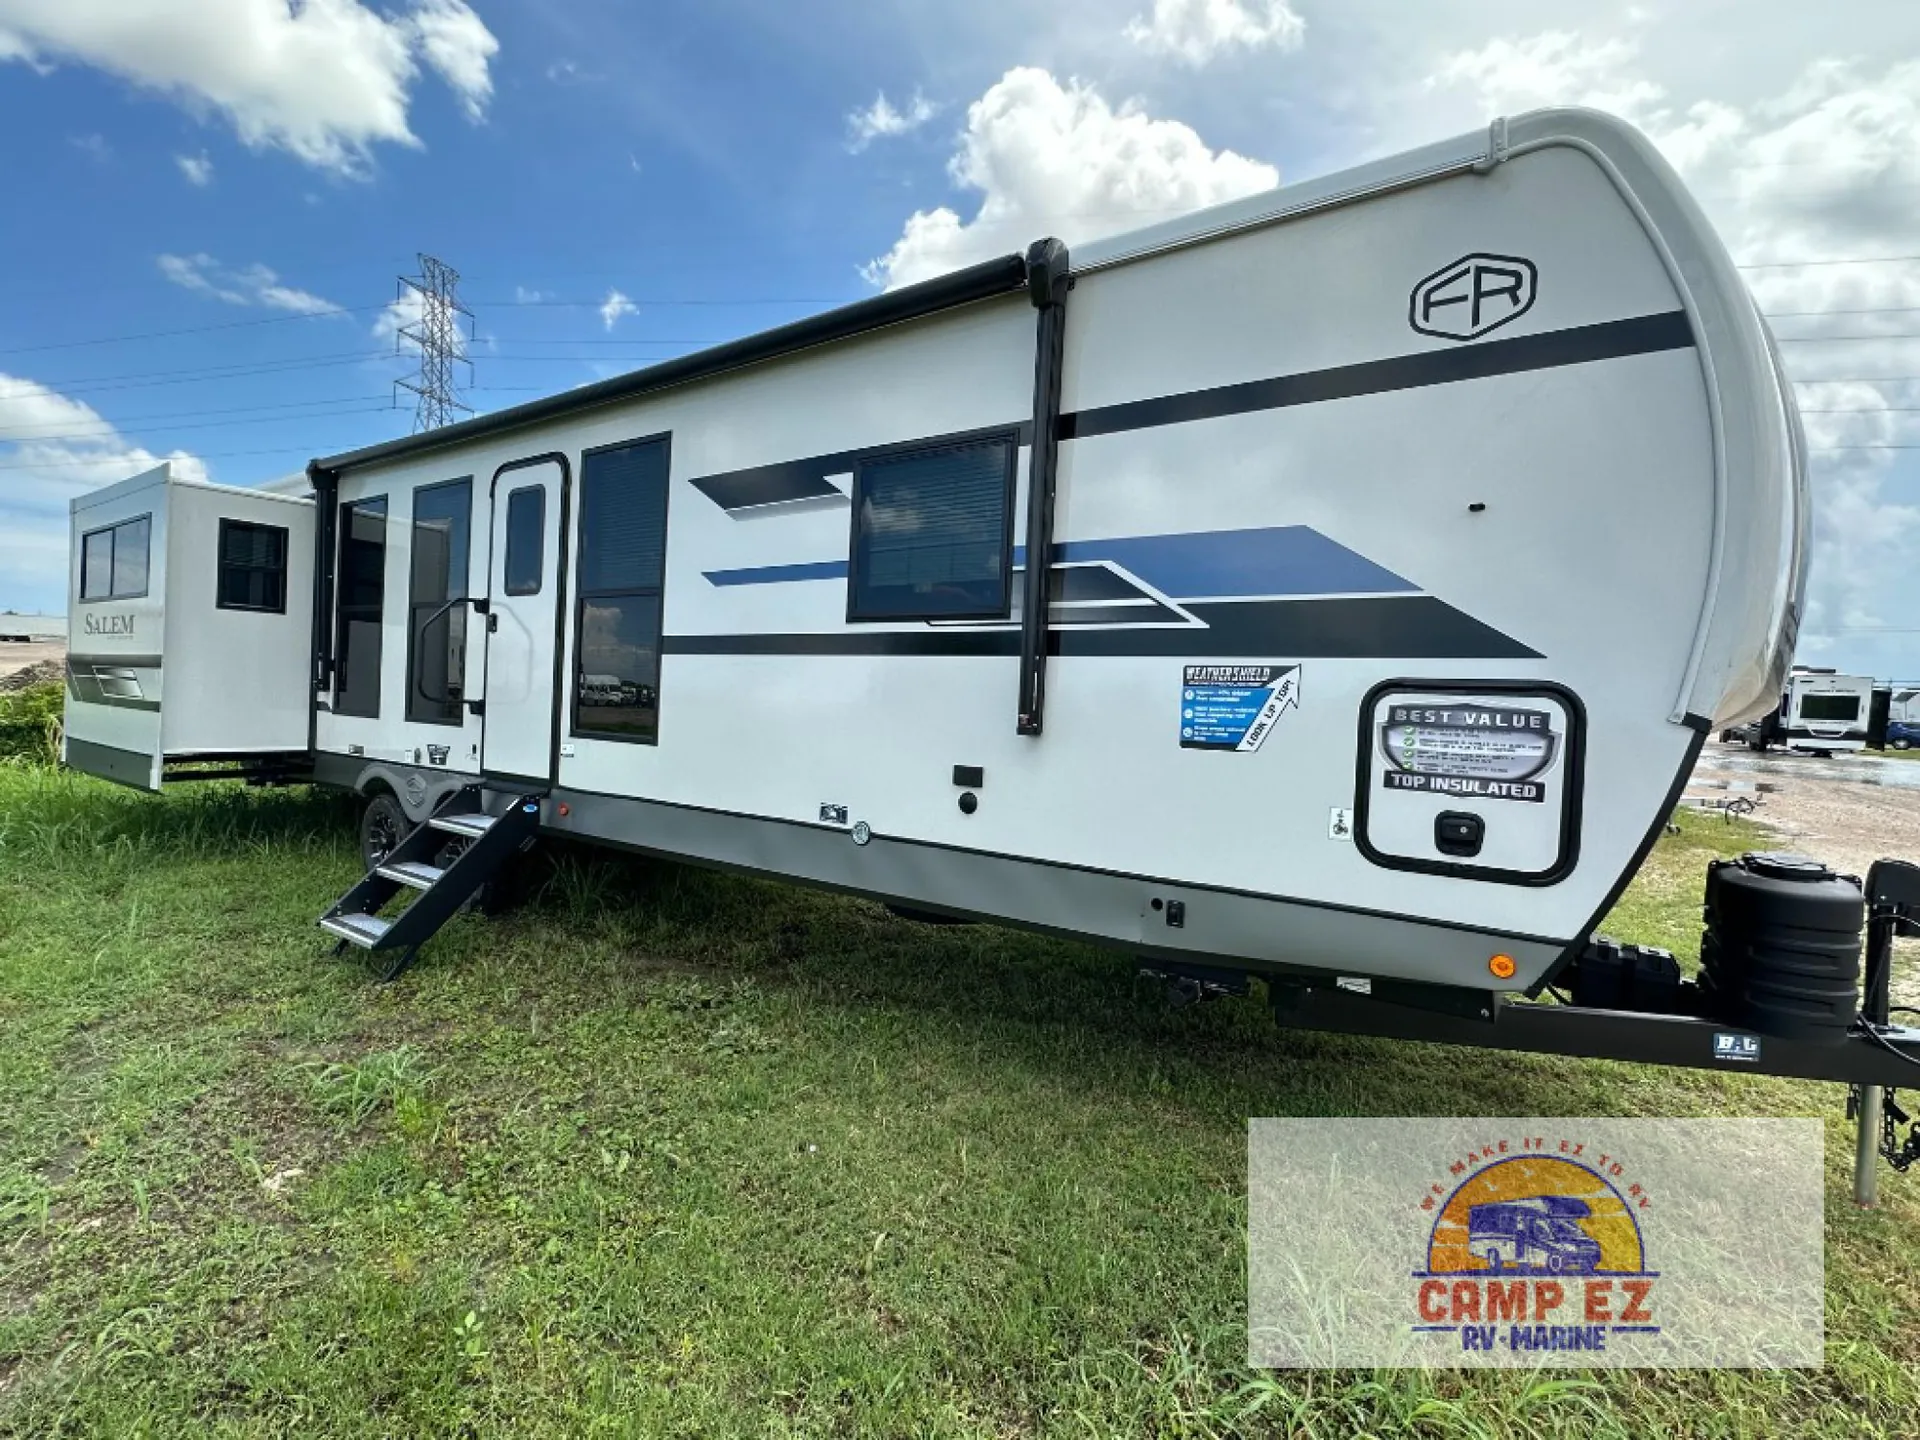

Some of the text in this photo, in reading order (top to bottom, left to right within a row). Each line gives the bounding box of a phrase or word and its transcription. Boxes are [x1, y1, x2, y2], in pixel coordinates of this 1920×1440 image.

[1247, 722, 1268, 746] LOOK
[1264, 704, 1275, 718] UP
[1394, 709, 1542, 728] BEST VALUE
[1390, 773, 1537, 798] TOP INSULATED
